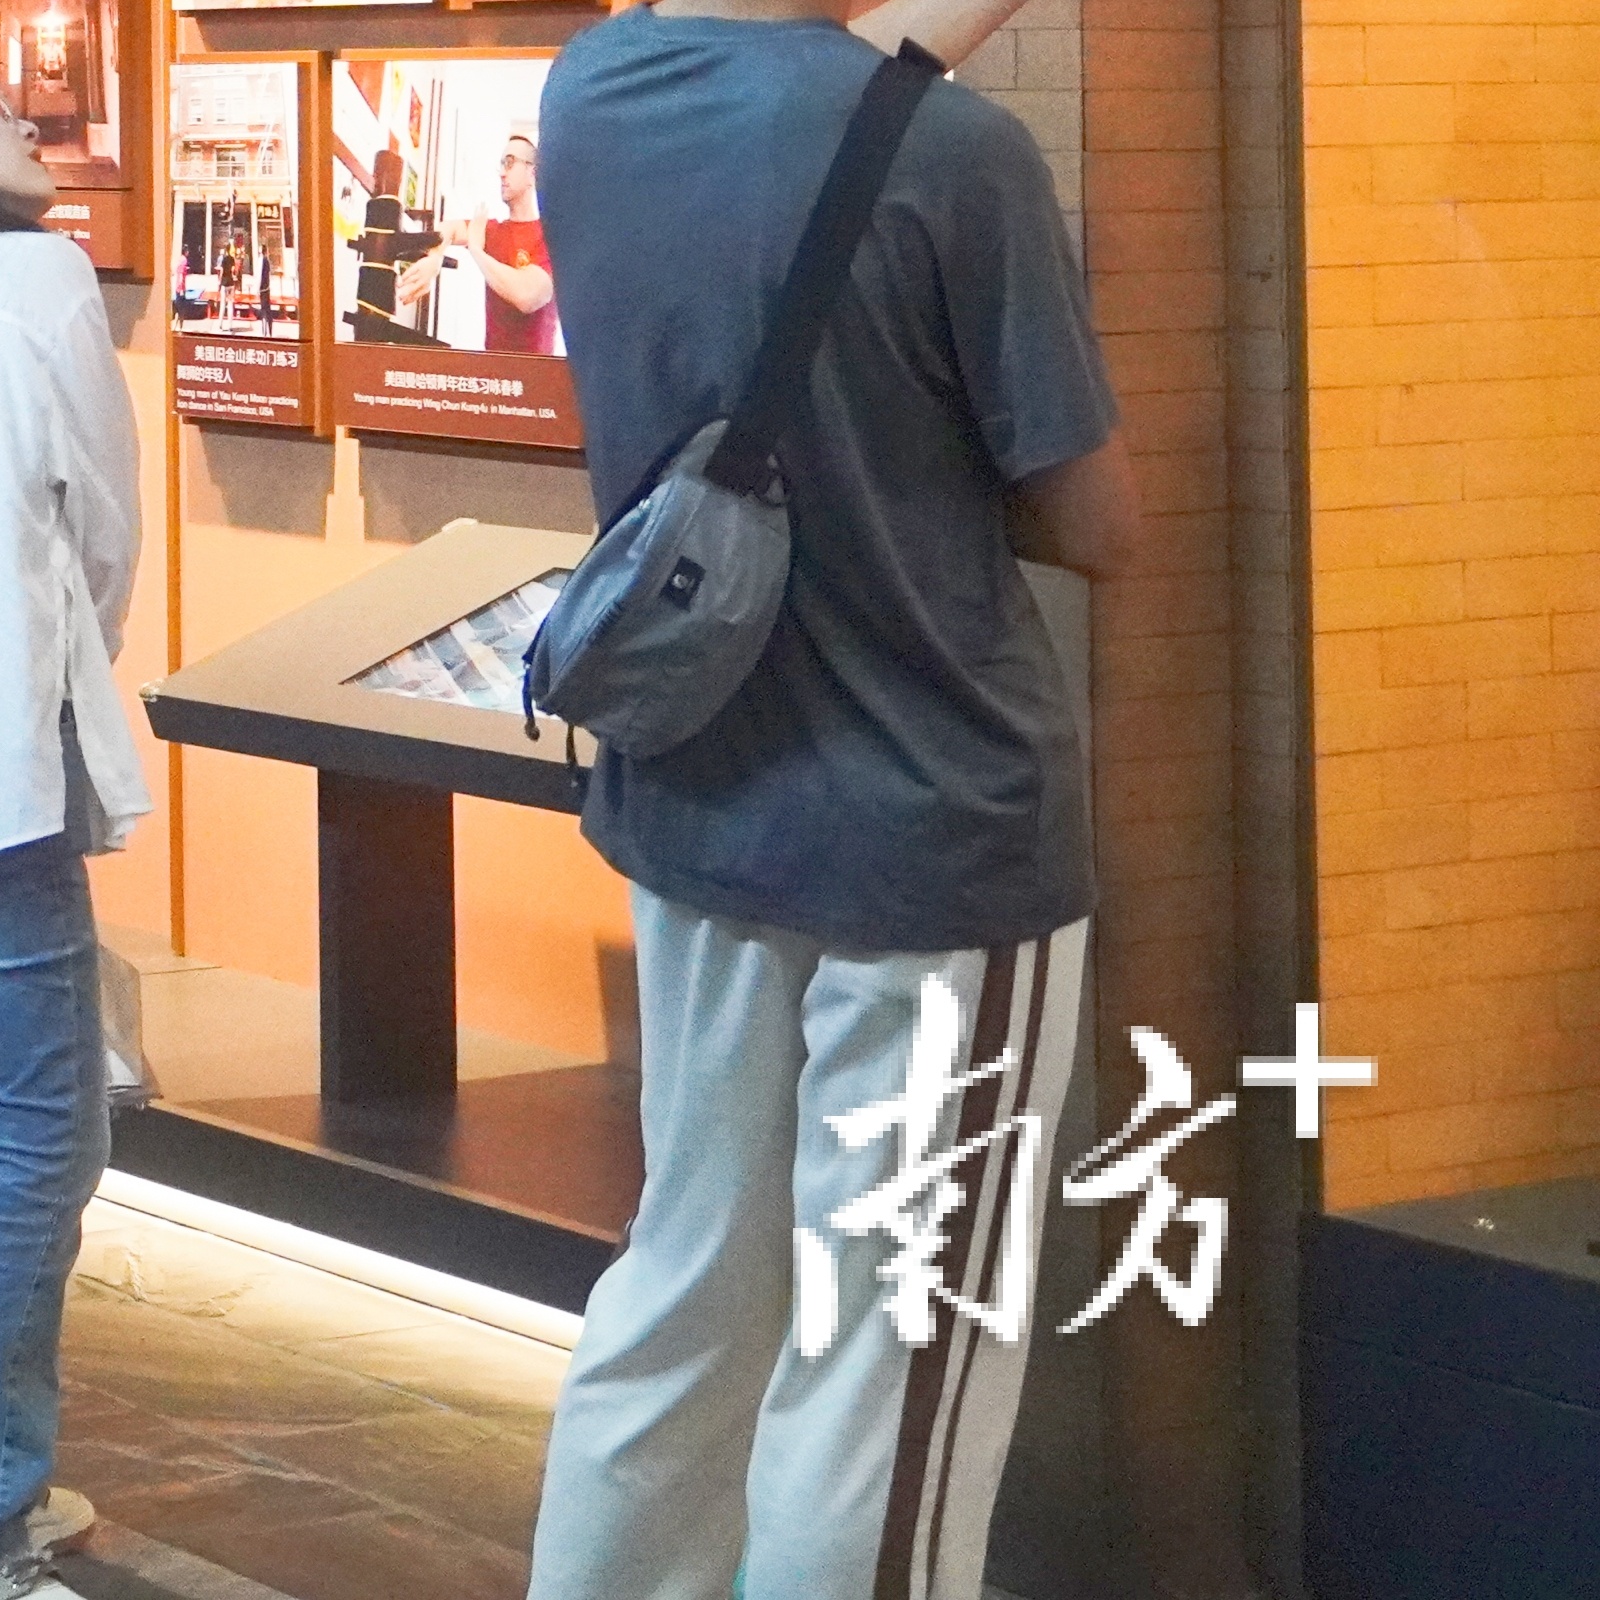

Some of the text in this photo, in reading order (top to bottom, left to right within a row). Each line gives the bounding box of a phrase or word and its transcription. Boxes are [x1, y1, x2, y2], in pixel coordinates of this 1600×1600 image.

[177, 388, 195, 400] Young
[211, 391, 218, 399] of
[259, 406, 274, 416] USA
[423, 399, 441, 411] Wing
[442, 400, 460, 411] Chun
[491, 404, 498, 413] in
